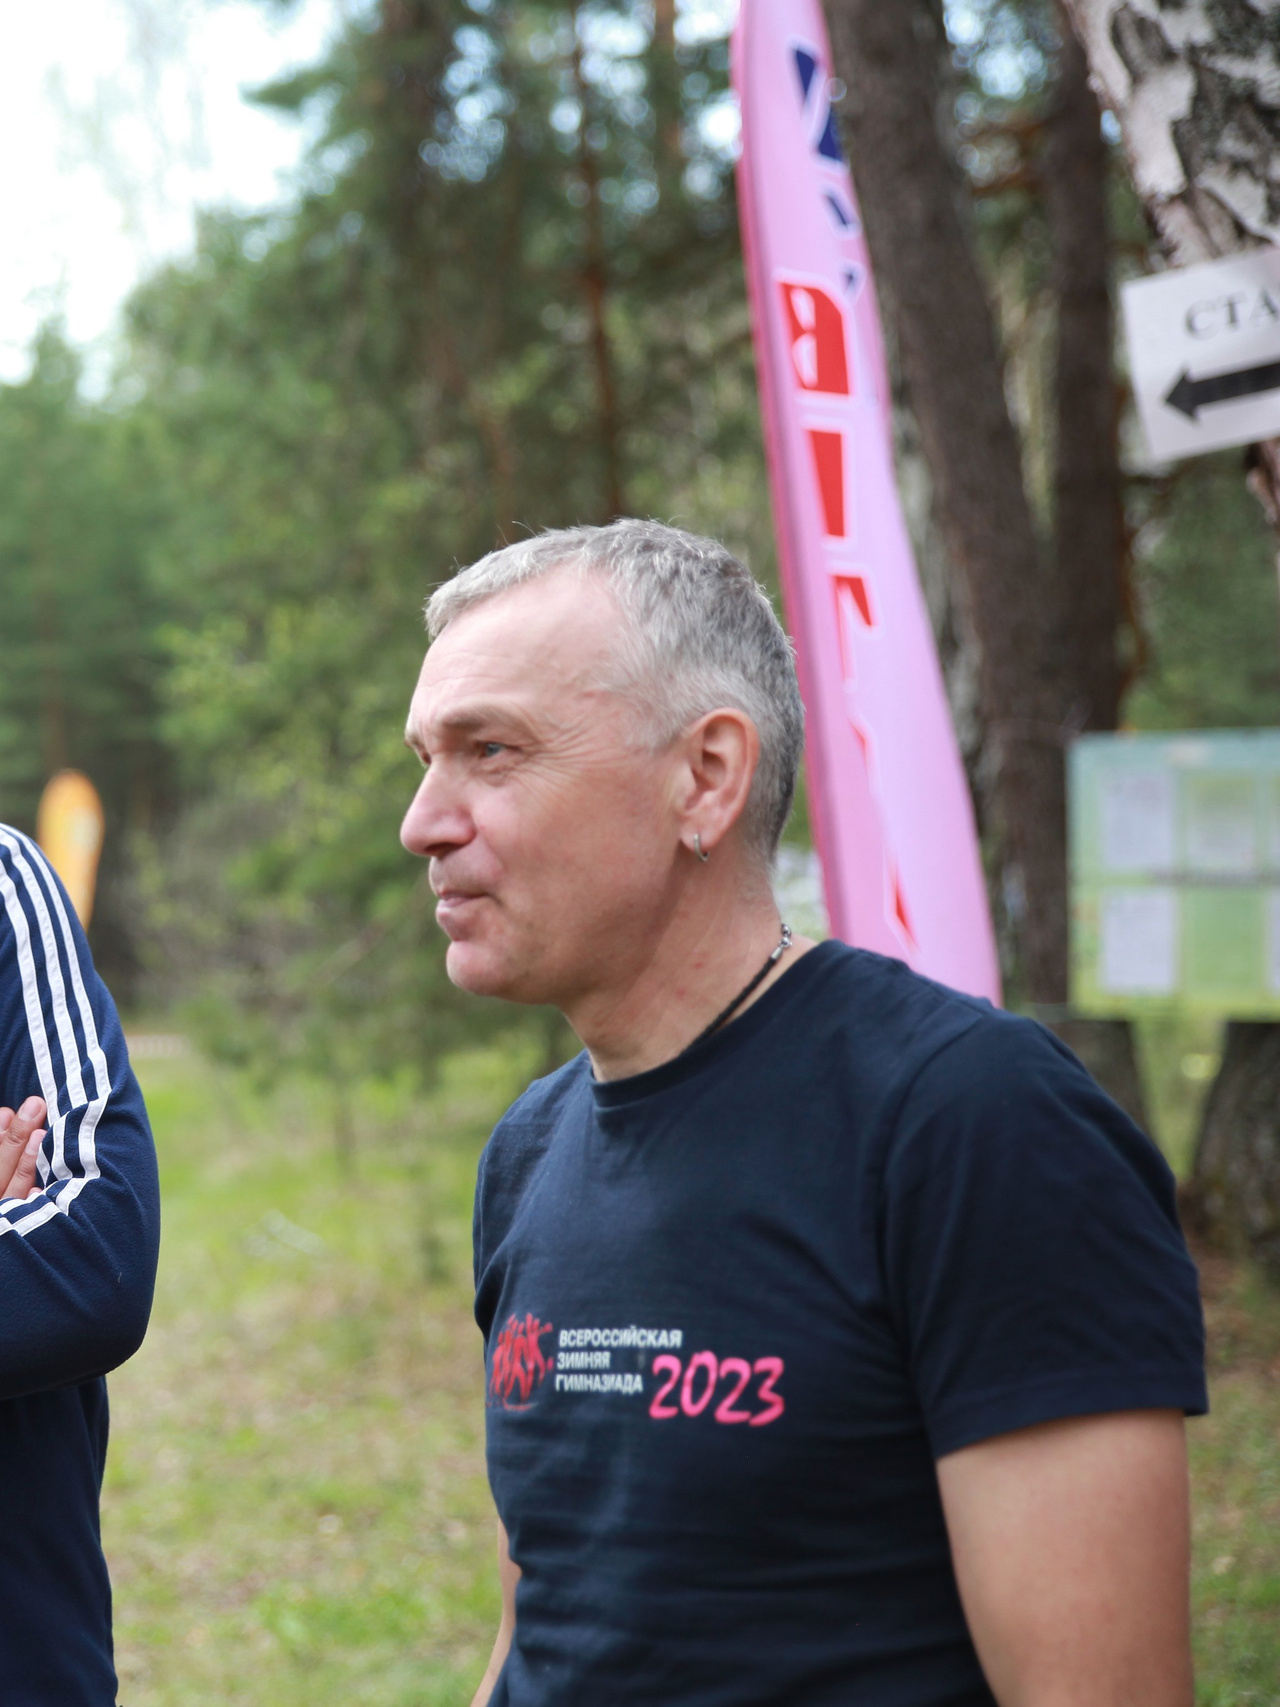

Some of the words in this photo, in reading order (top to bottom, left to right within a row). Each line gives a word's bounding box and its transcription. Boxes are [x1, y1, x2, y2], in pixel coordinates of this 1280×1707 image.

[559, 1325, 682, 1348] ВСЕРОССИЙСКАЯ
[557, 1351, 611, 1369] ЗИМНЯЯ
[555, 1374, 643, 1395] ГИМНАЗИАДА
[649, 1350, 785, 1427] 2023
